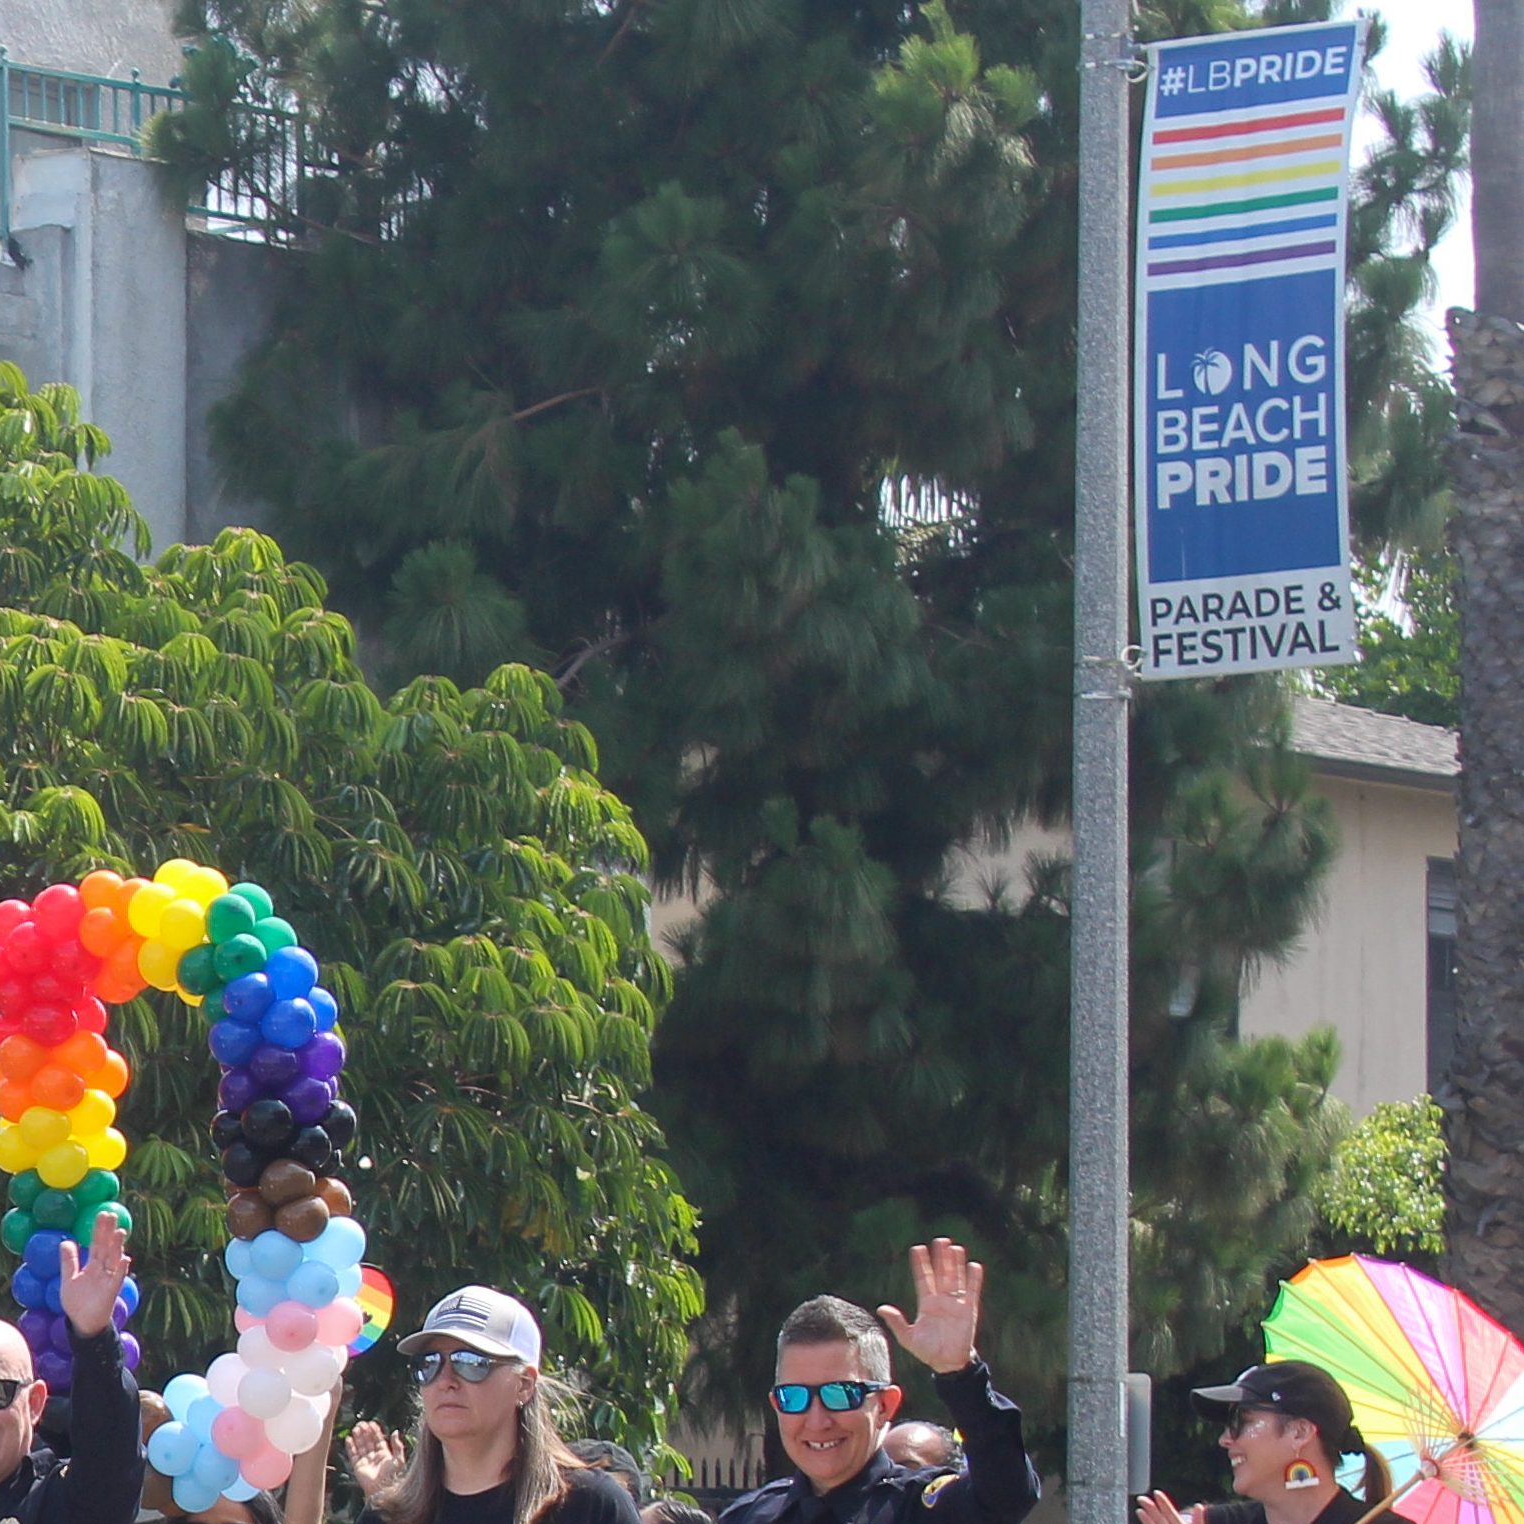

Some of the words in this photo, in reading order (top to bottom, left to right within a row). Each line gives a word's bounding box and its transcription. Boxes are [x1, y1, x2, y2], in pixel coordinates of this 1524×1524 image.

[1160, 46, 1347, 96] #LBPRIDE
[1157, 334, 1326, 400] LONG
[1157, 392, 1326, 454] BEACH
[1156, 445, 1328, 510] PRIDE
[1150, 584, 1305, 627] PARADE
[1317, 581, 1342, 612] &
[1152, 619, 1340, 668] FESTIVAL
